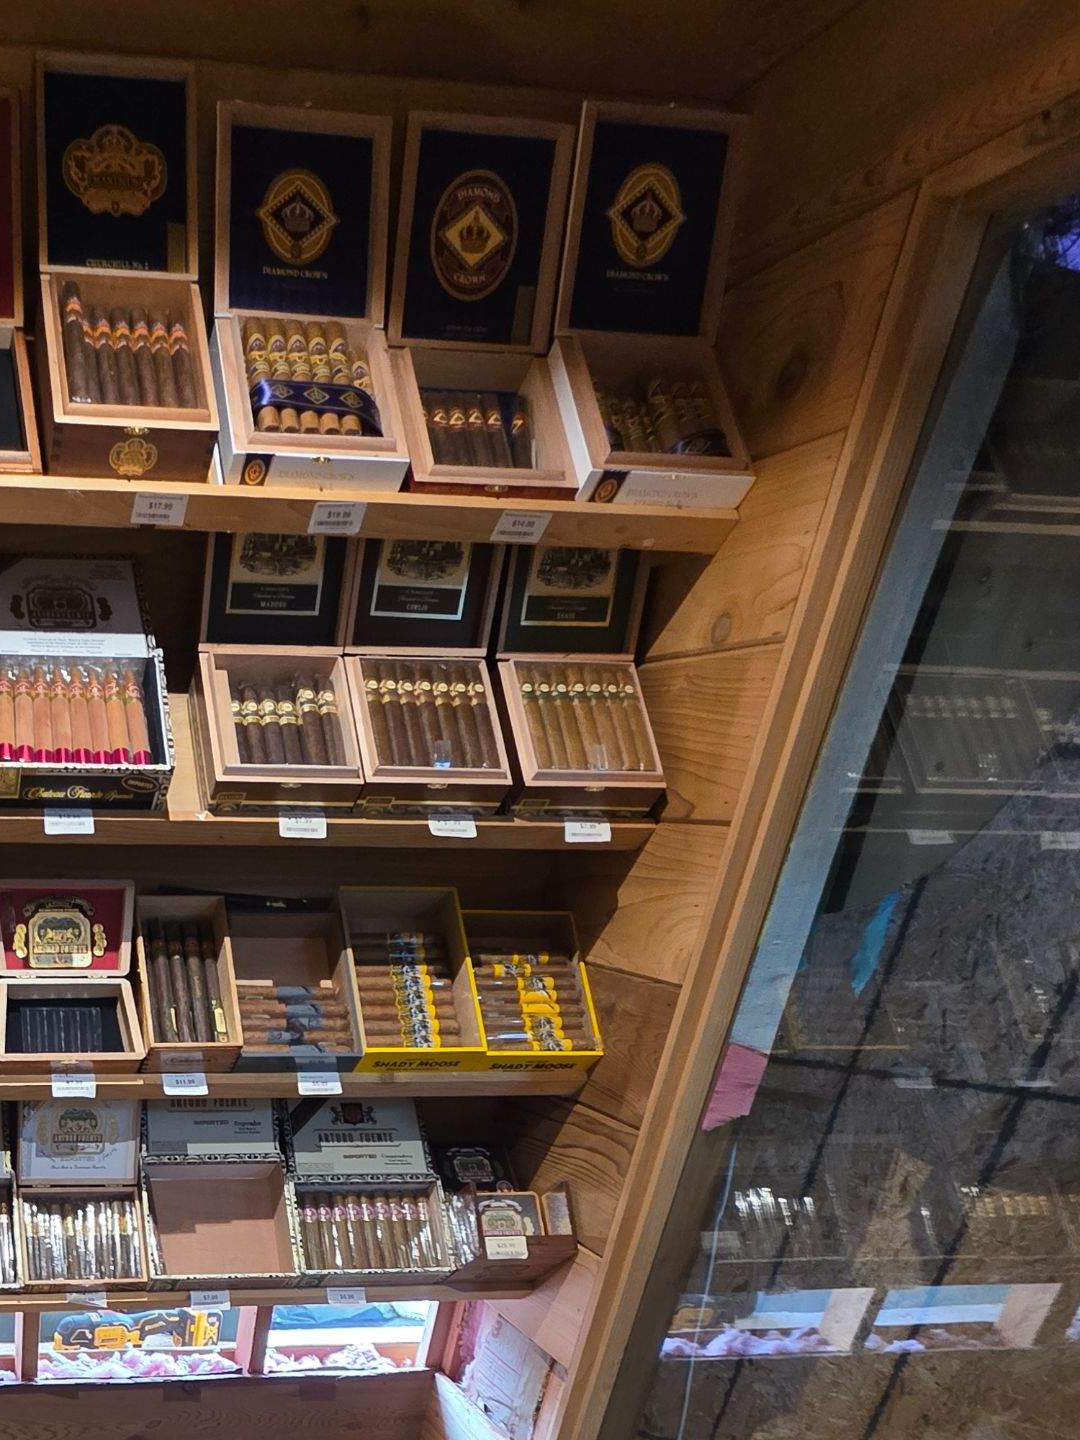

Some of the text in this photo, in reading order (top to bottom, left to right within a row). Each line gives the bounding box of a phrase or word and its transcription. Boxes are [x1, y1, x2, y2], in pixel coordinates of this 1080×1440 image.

[373, 1058, 461, 1069] SHADY MOOSE
[491, 1061, 576, 1071] SHADY MOOSE
[319, 1130, 395, 1143] ARTURO FUENTE
